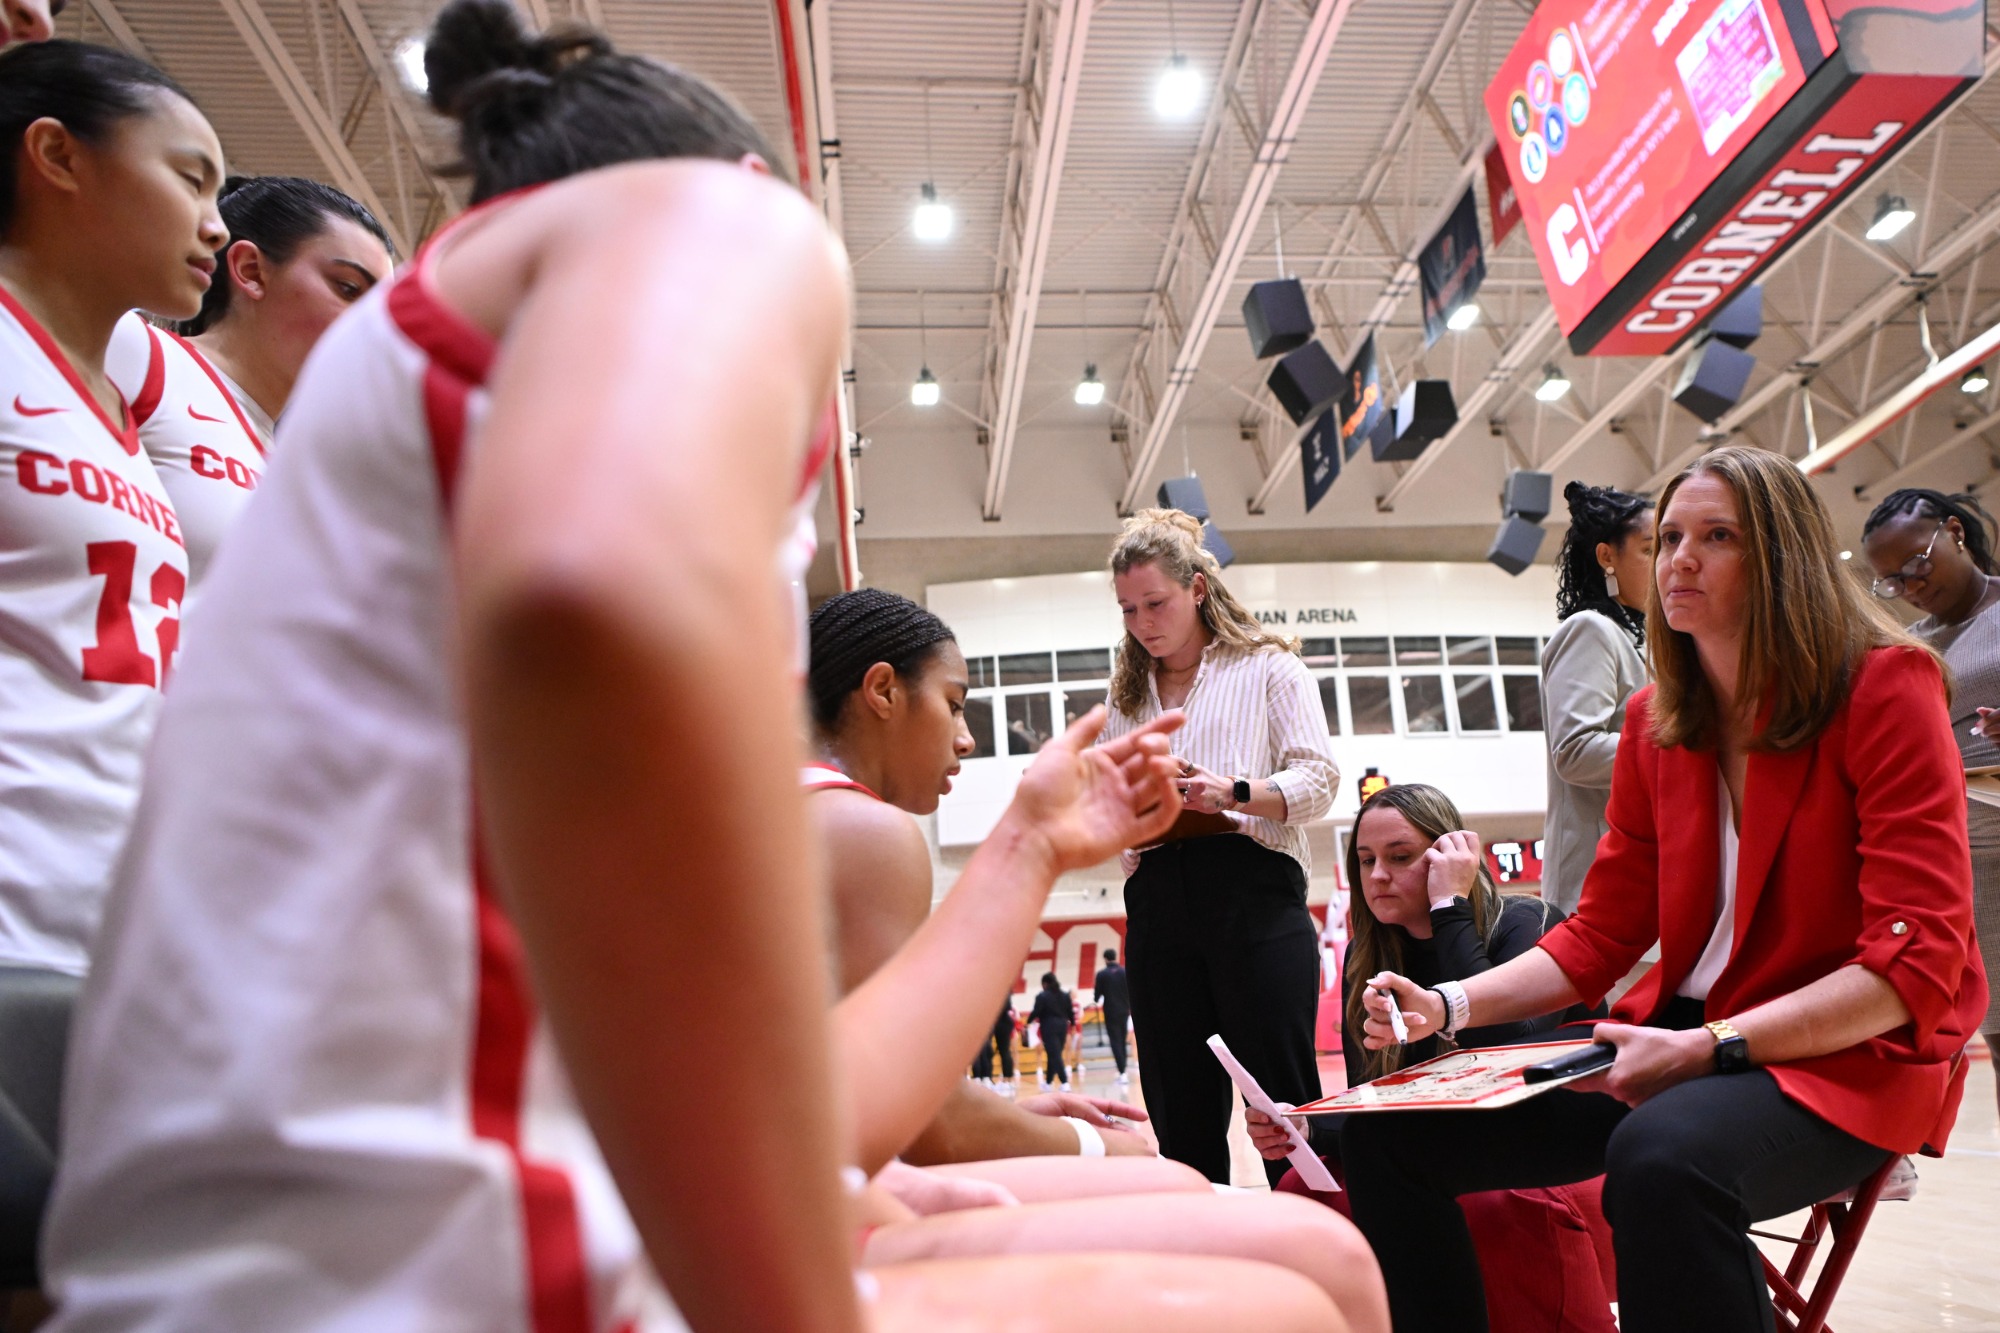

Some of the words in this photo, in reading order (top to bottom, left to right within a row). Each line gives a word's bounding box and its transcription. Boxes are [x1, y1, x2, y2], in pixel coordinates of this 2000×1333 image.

[1546, 203, 1589, 286] C
[1626, 121, 1904, 333] CORNELL
[1296, 608, 1357, 624] ARENA
